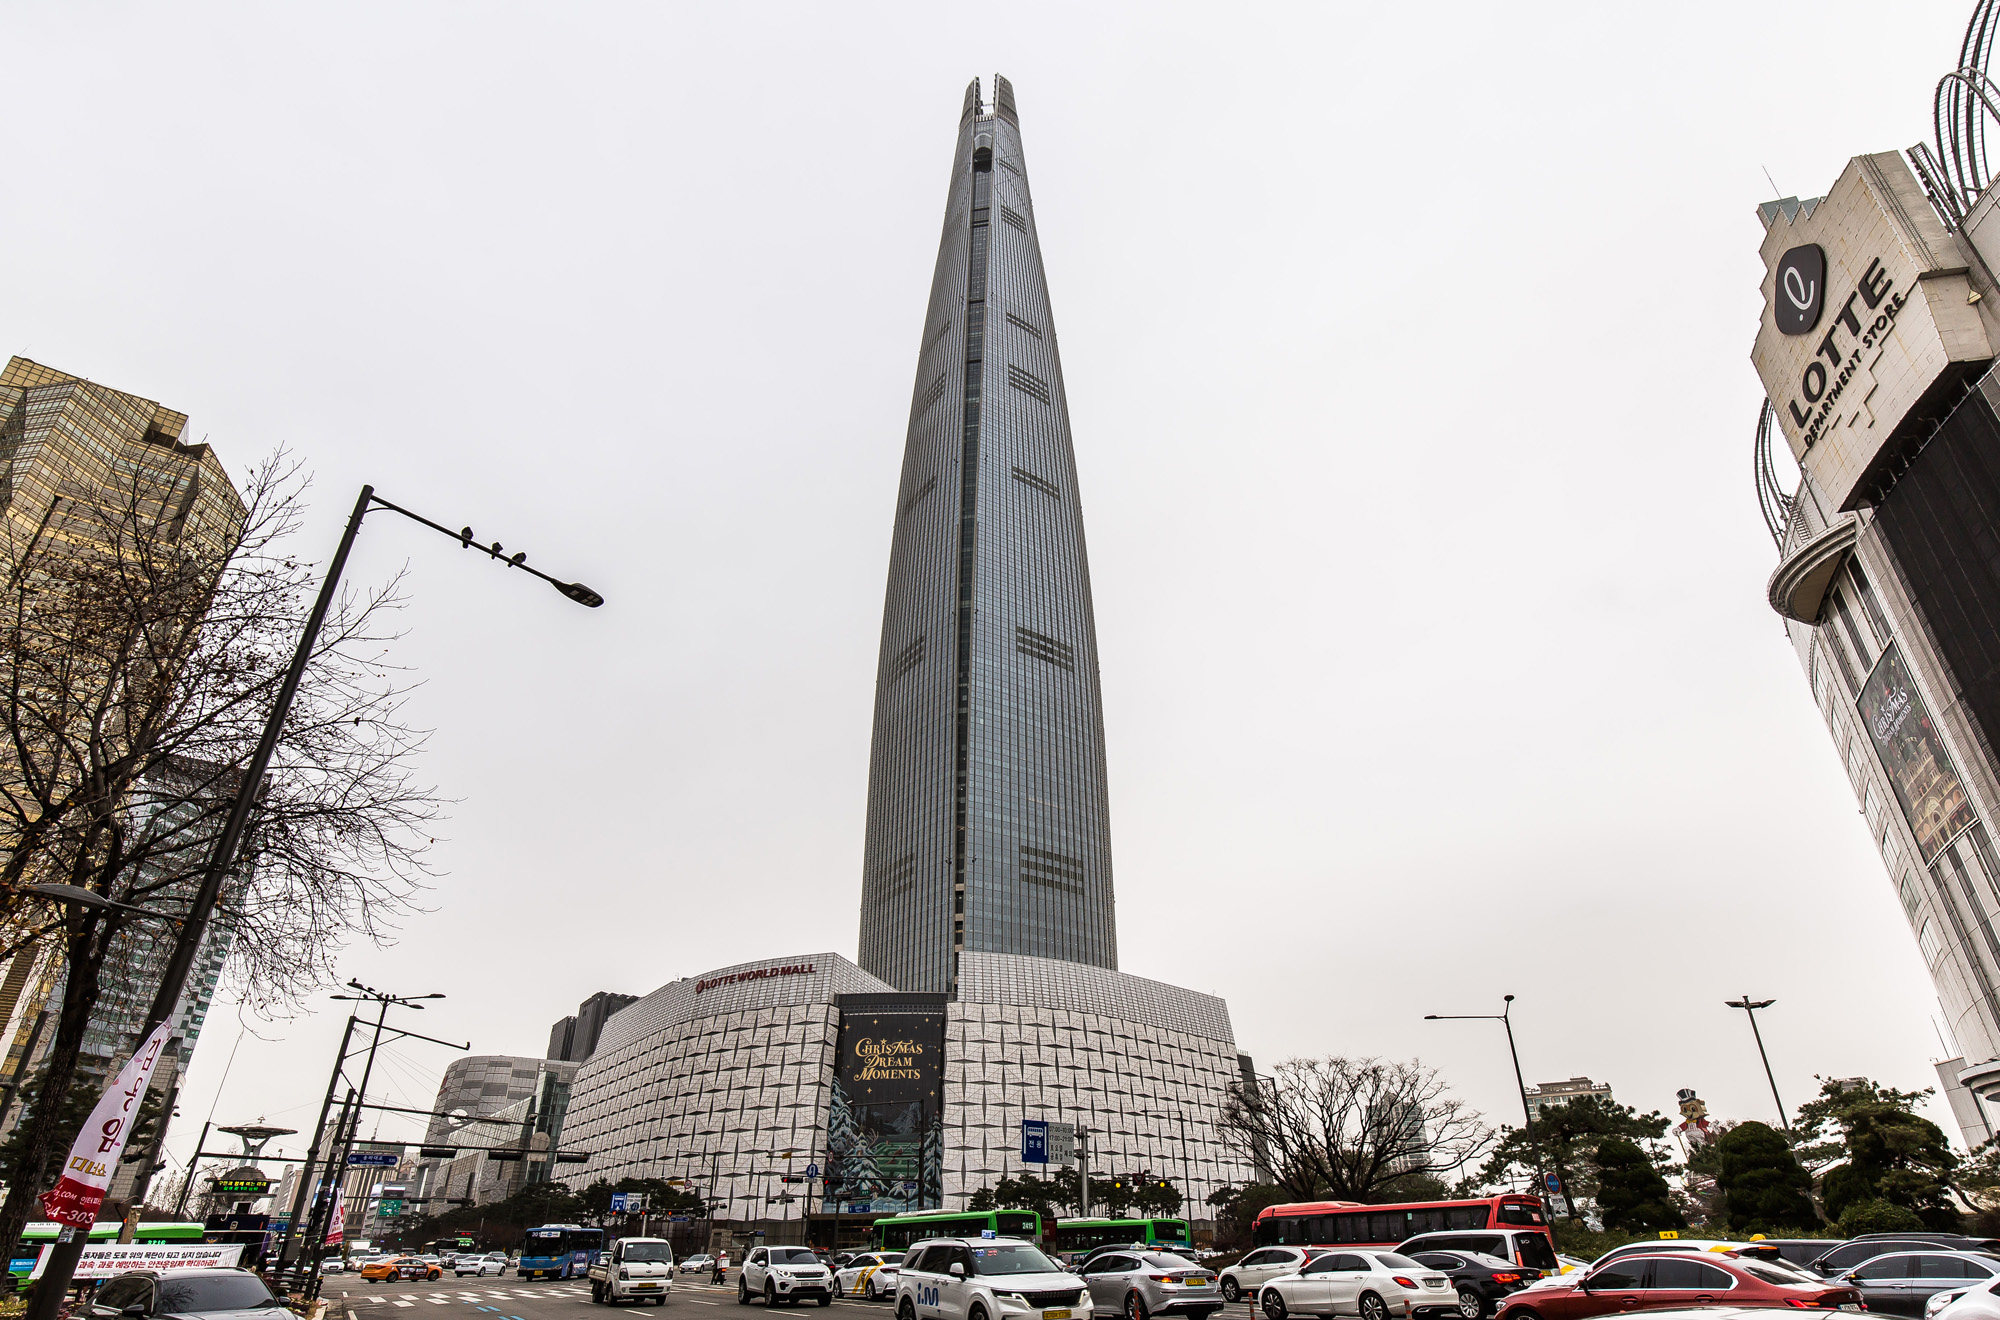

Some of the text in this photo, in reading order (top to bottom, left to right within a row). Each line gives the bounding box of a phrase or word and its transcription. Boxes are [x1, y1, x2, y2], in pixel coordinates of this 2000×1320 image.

[1788, 256, 1893, 429] LOTTE
[1803, 292, 1904, 448] DEPARTMENT STORE
[1872, 686, 1908, 740] CHRISTMAS
[705, 963, 817, 990] LOTTE WORLD MALL
[855, 1037, 923, 1057] CHRISTMAS
[863, 1053, 913, 1068] DREAM
[853, 1067, 921, 1082] MOMENTS
[69, 1156, 106, 1177] 디너쇼
[112, 1251, 128, 1259] 도로
[128, 1251, 143, 1259] 위의
[143, 1251, 165, 1259] 폭탄이
[166, 1251, 180, 1259] 되고
[181, 1251, 196, 1259] 싶지
[195, 1251, 222, 1259] 않습니다
[115, 1260, 147, 1269] 예방하는
[147, 1259, 185, 1268] 안전운임제
